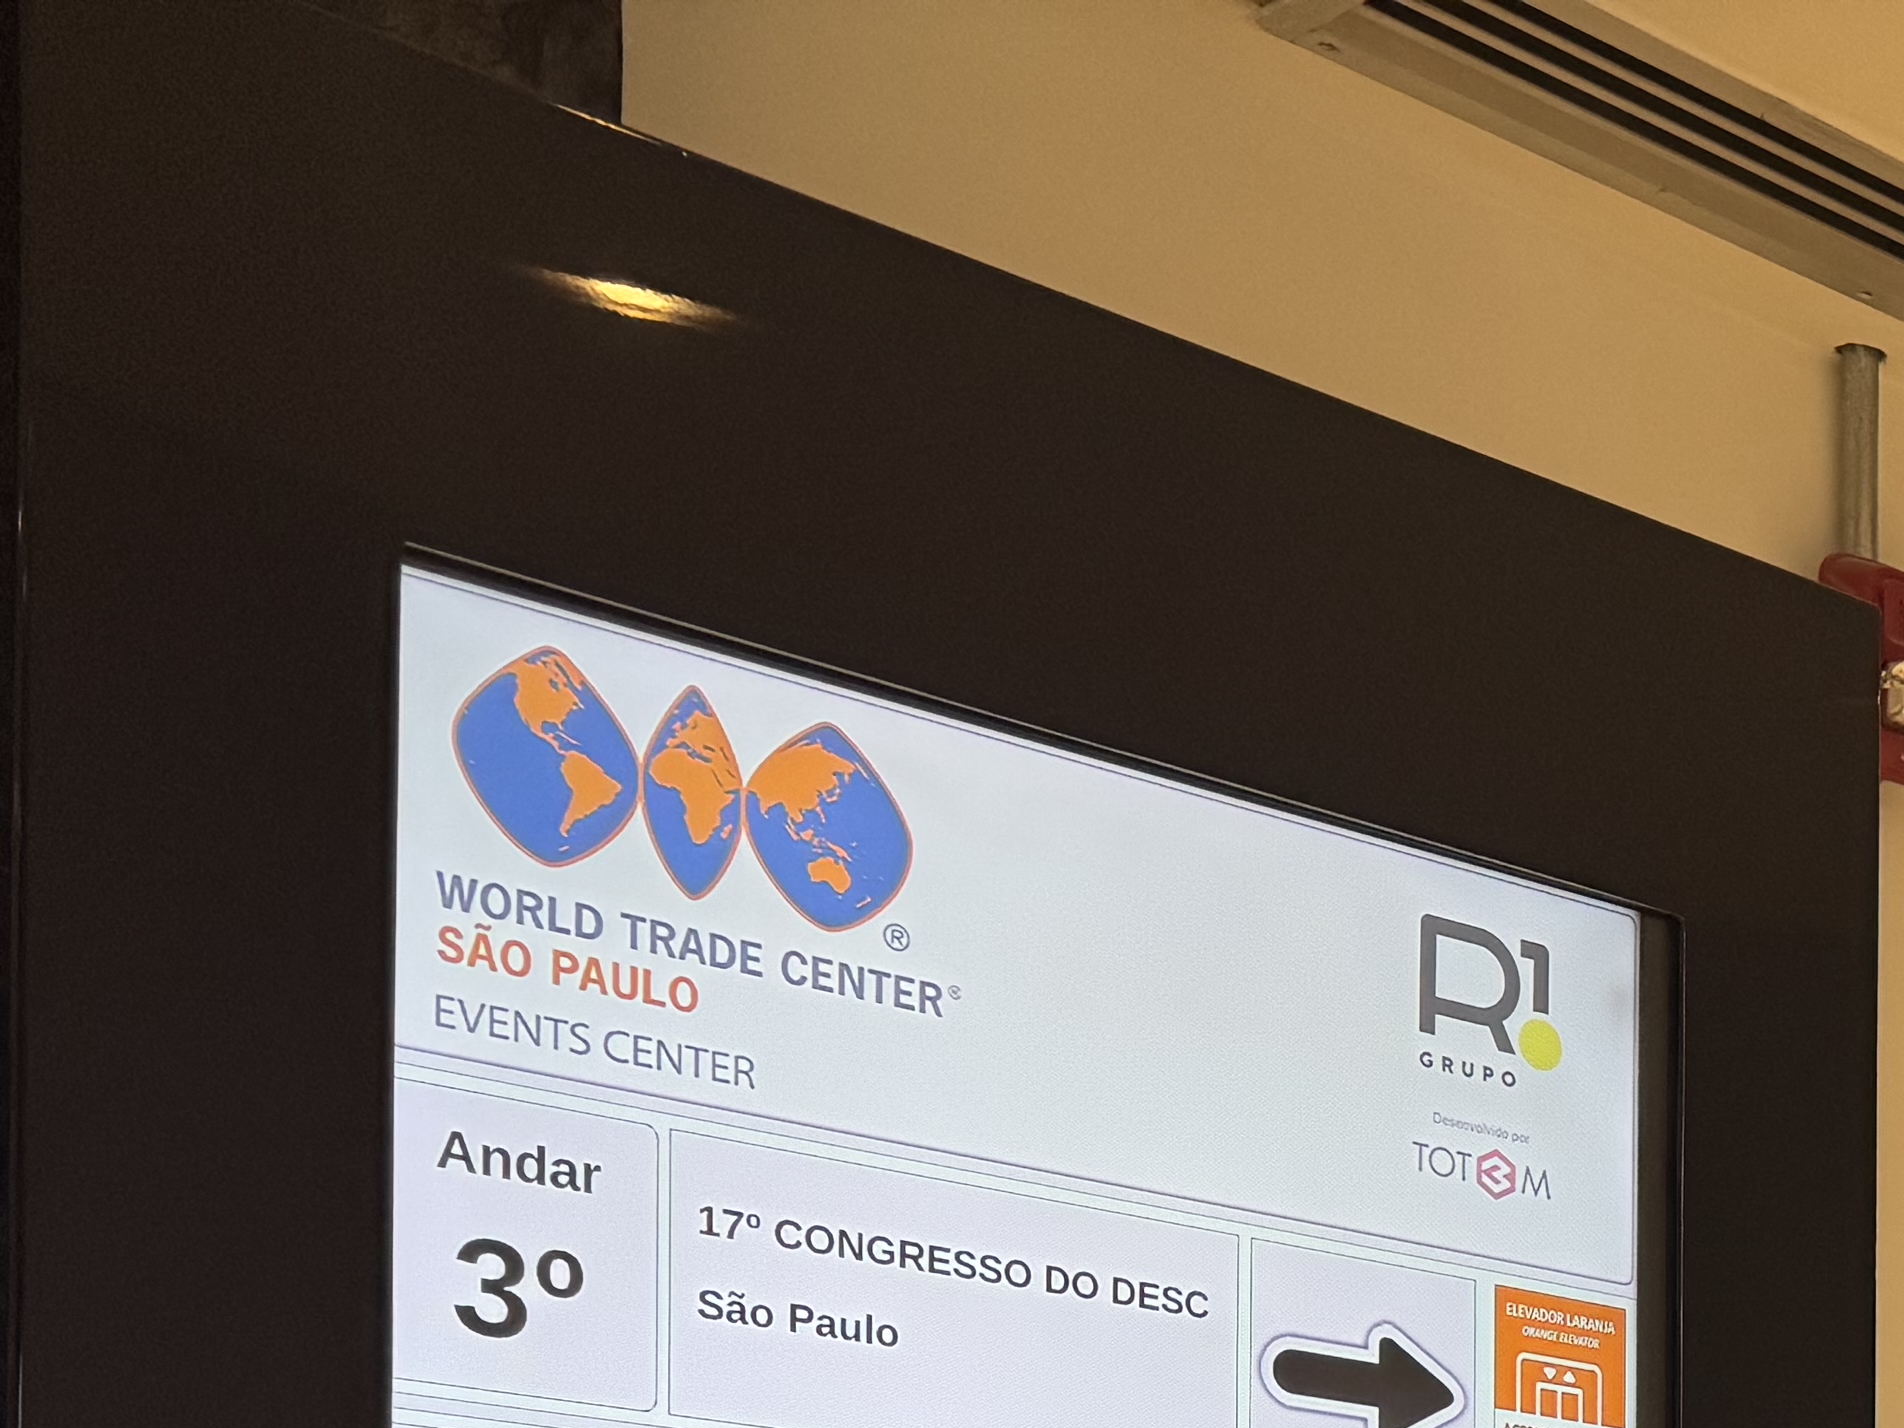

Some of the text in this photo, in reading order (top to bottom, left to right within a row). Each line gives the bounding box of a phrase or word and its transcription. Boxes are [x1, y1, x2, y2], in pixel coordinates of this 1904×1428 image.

[436, 870, 602, 940] WORLD
[621, 911, 764, 978] TRADE
[436, 923, 698, 1013] SÃO PAULO
[435, 994, 755, 1089] EVENTS CENTER
[1419, 1051, 1517, 1087] GRUPO
[436, 1130, 601, 1194] Andar
[775, 1219, 1032, 1288] CONGRESSO
[1045, 1265, 1099, 1299] DO
[1112, 1277, 1209, 1319] DESC
[698, 1290, 898, 1347] São Paulo
[1506, 1302, 1616, 1335] ELEVADOR LARANJA
[1522, 1326, 1600, 1349] ORANGE ELEVATOR
